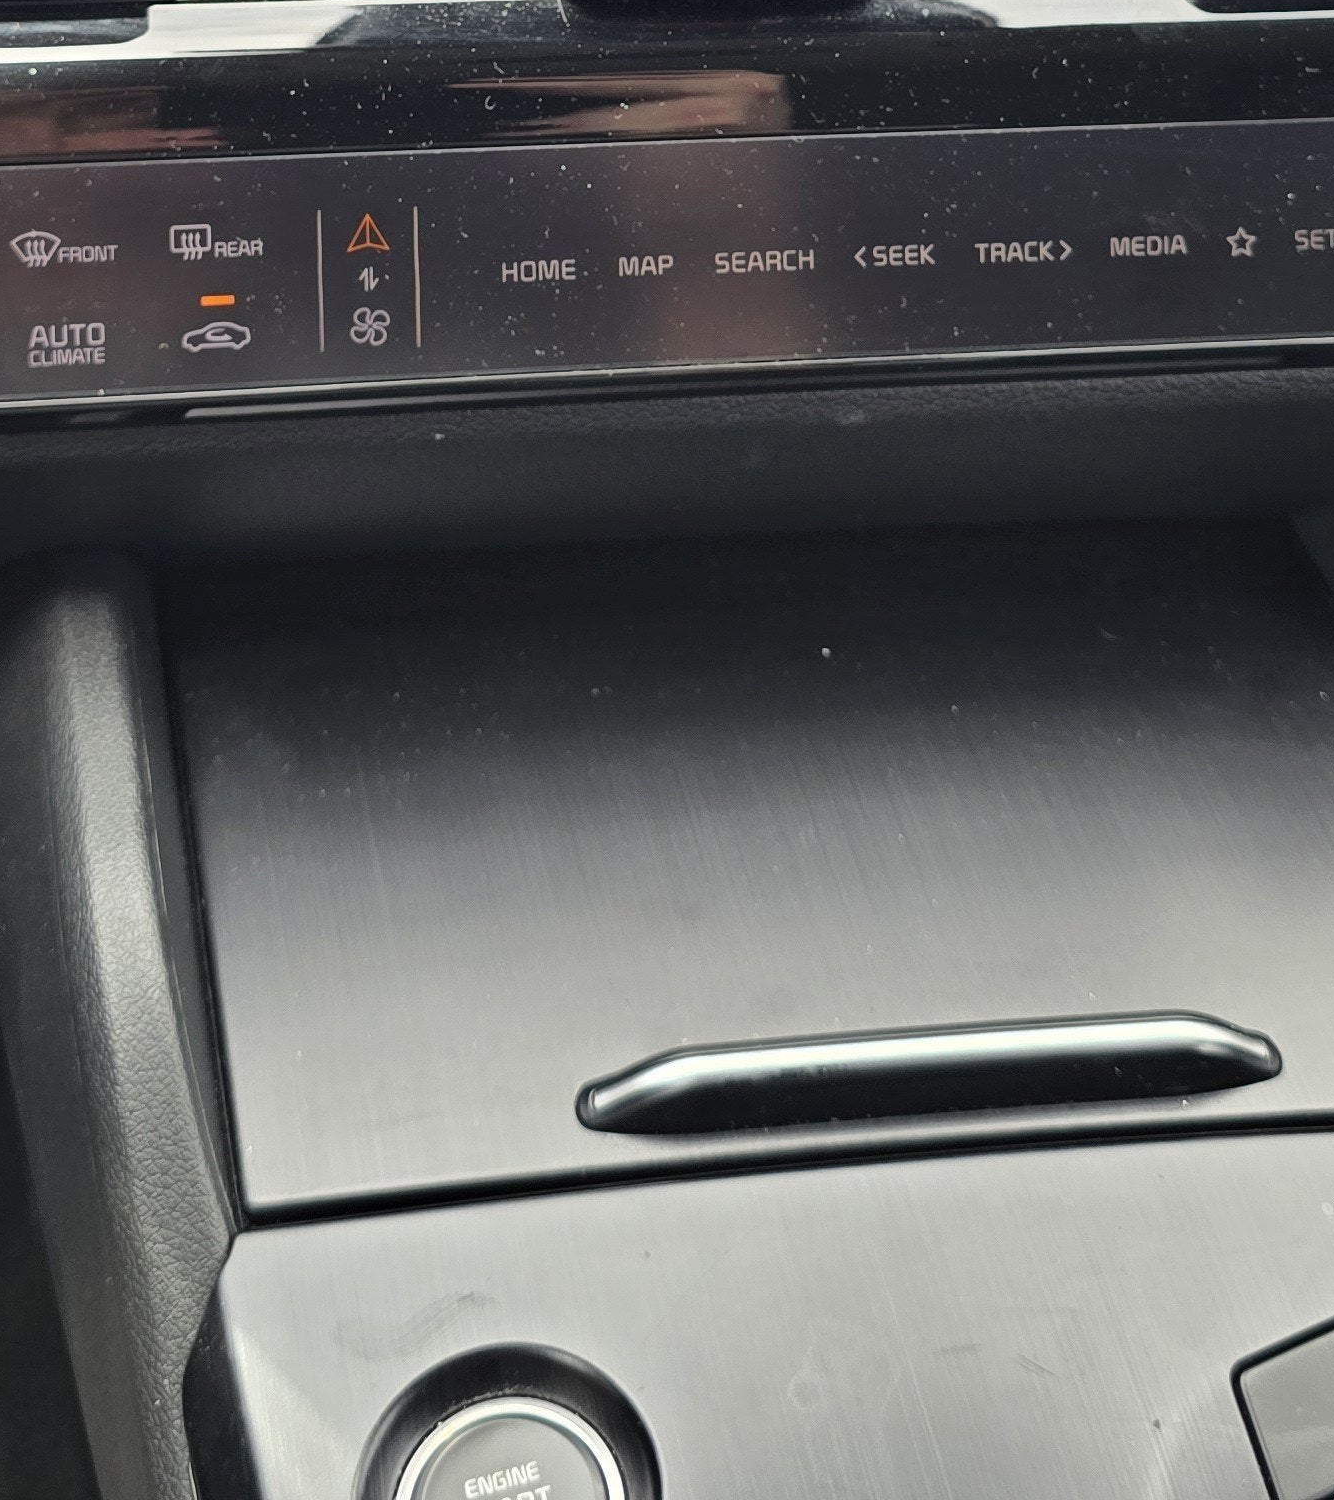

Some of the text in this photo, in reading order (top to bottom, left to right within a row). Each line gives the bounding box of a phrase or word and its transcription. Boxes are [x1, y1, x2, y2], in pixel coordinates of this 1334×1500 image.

[60, 245, 118, 263] FRONT
[213, 239, 264, 258] REAR
[1109, 235, 1188, 257] MEDIA
[501, 258, 577, 283] HOME
[618, 255, 674, 278] MAP
[714, 249, 815, 275] SEARCH
[28, 323, 107, 348] AUTO
[27, 347, 107, 367] CLIMATE
[464, 1460, 540, 1499] ENGINE
